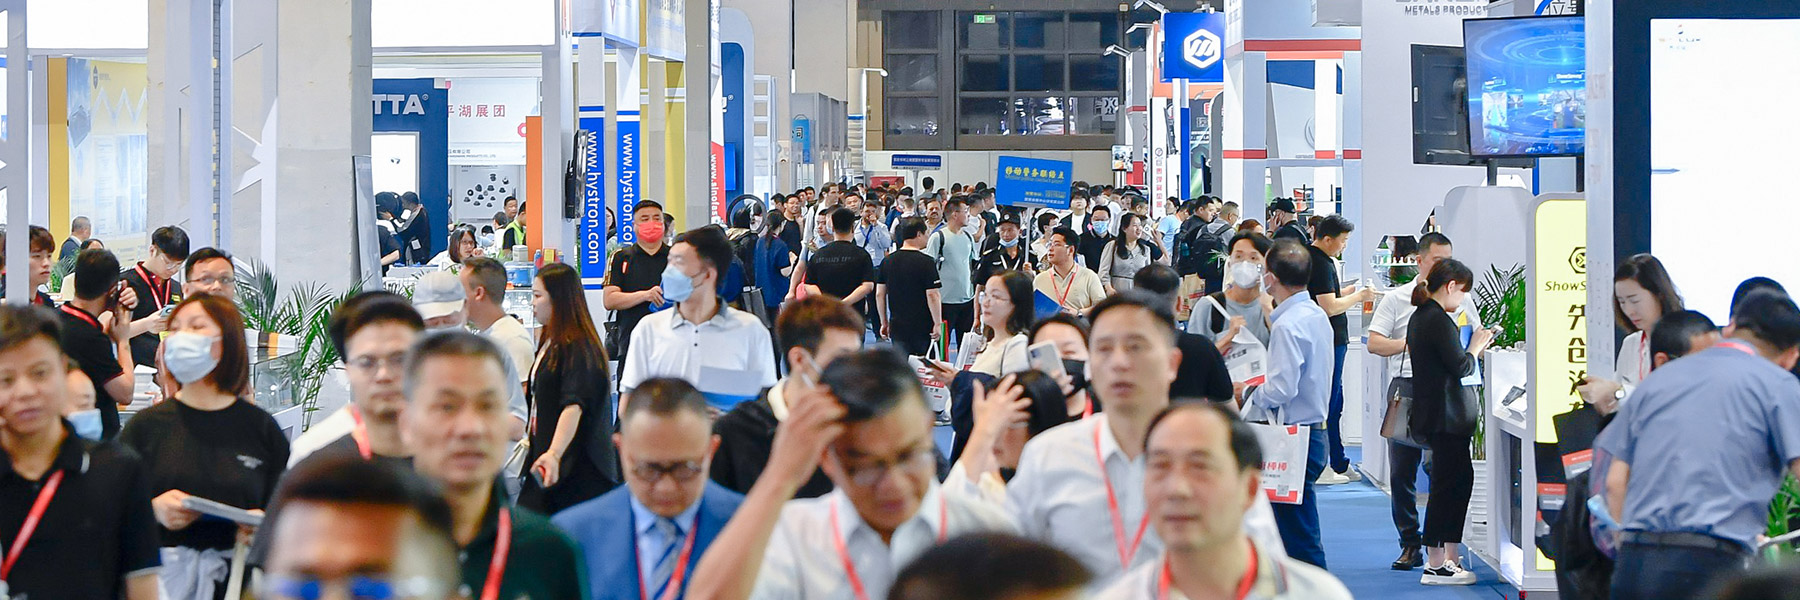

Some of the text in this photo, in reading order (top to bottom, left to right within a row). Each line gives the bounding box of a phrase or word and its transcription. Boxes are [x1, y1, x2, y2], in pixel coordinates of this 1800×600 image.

[1405, 6, 1440, 16] METALS
[586, 131, 601, 264] www.hystron.com
[619, 133, 636, 244] www.hystron.co
